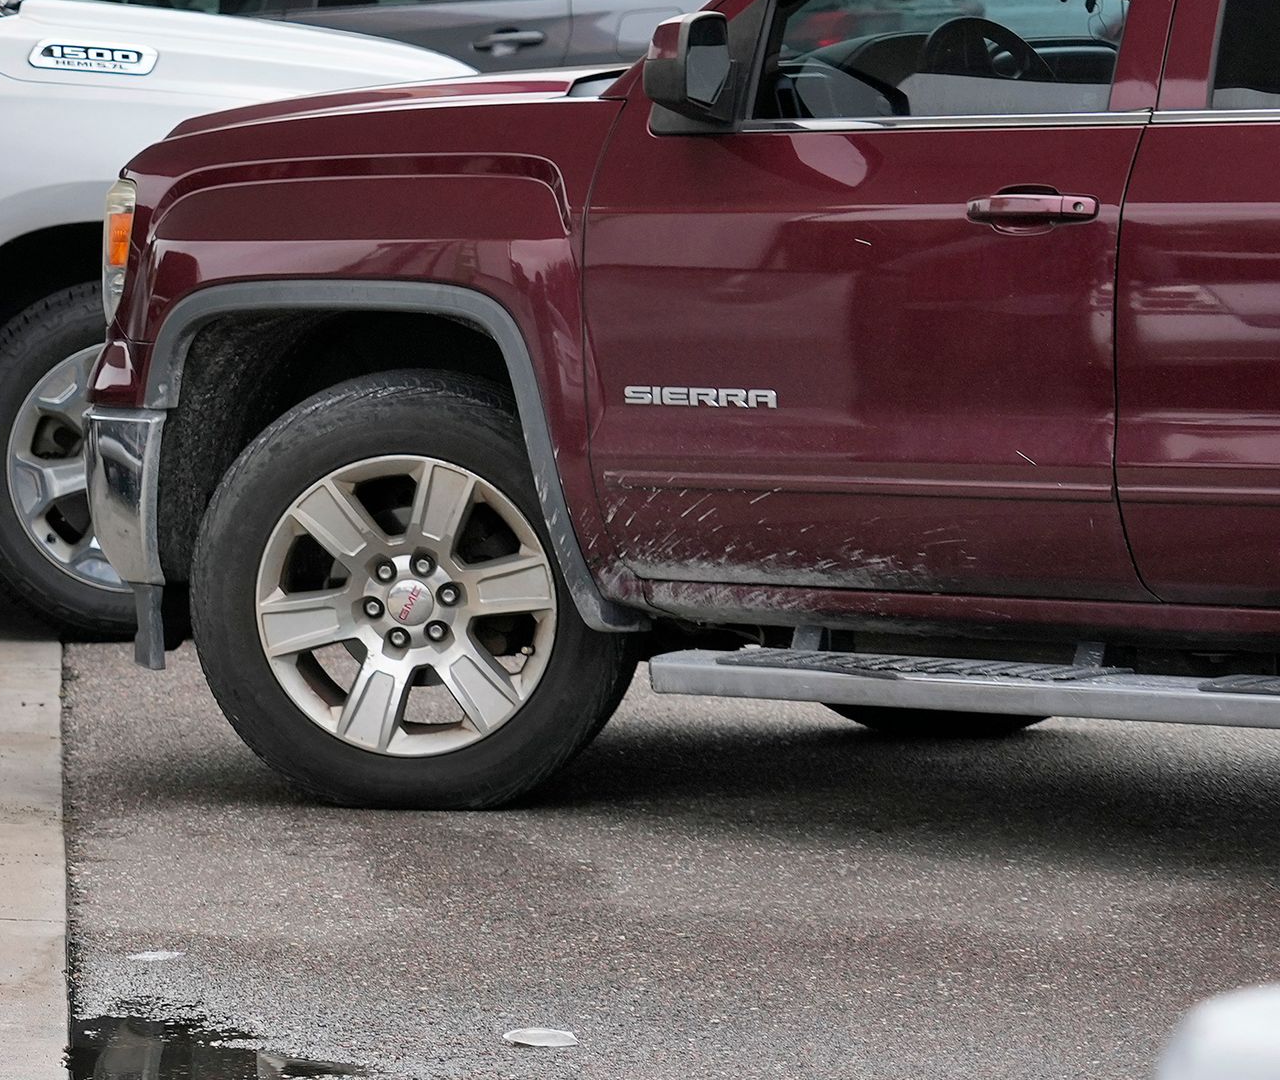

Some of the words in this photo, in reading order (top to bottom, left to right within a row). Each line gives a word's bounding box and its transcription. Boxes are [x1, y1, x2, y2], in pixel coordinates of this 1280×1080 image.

[51, 45, 139, 63] 1500
[55, 59, 92, 68] HEMI
[624, 385, 778, 409] SIERRA
[398, 585, 422, 621] GMC
